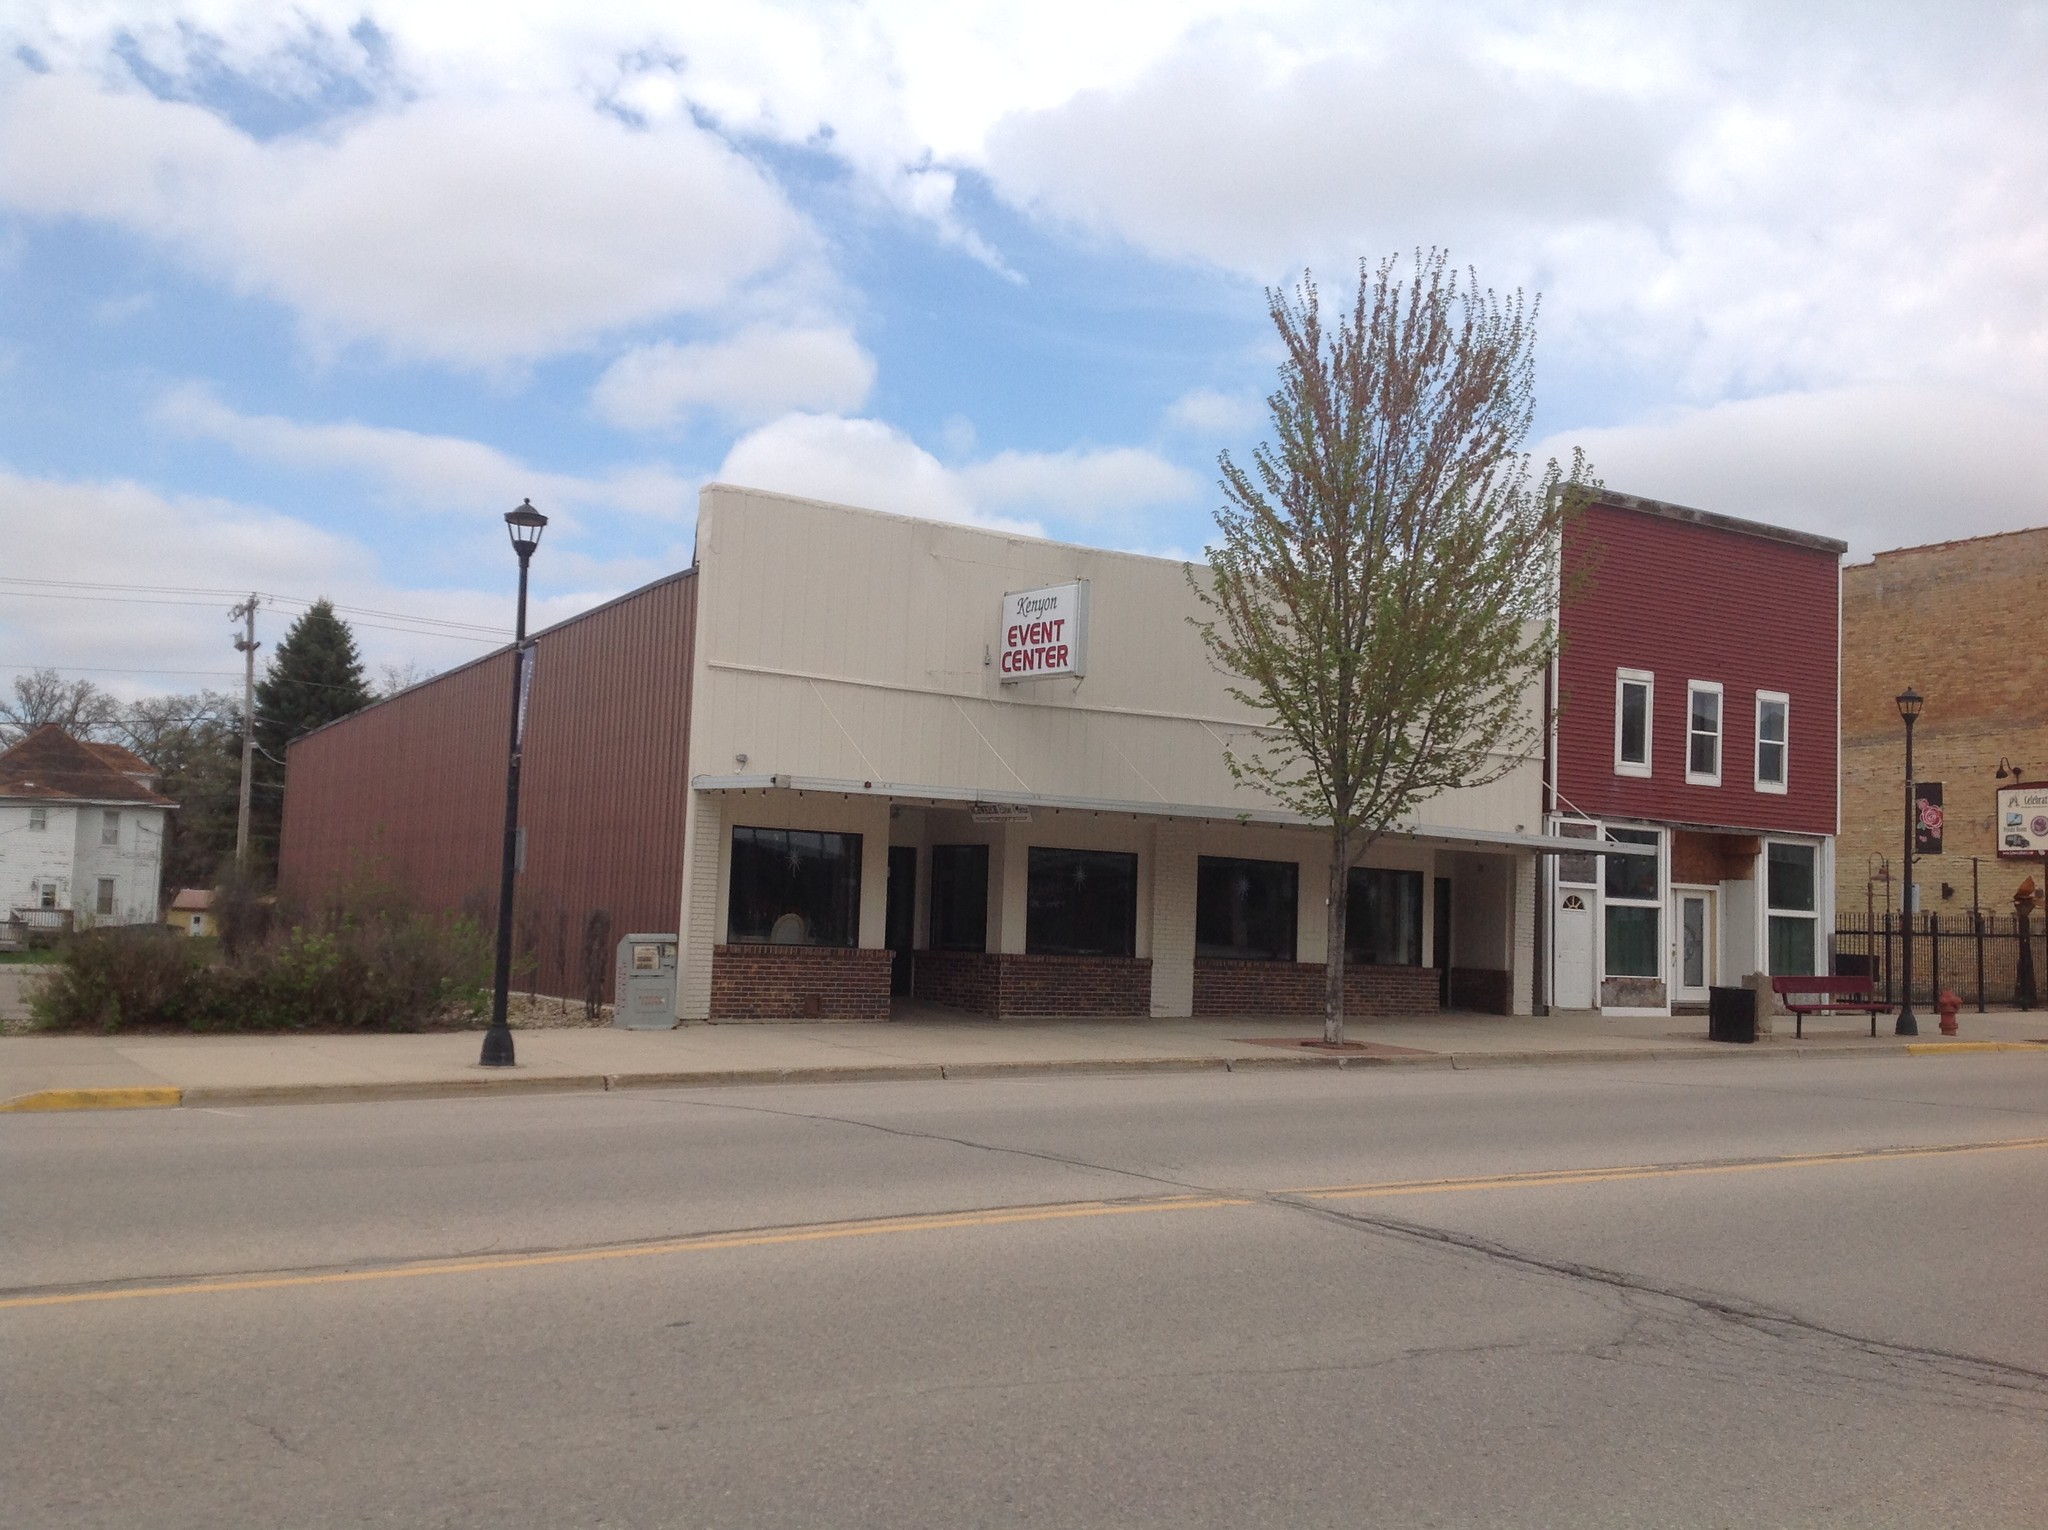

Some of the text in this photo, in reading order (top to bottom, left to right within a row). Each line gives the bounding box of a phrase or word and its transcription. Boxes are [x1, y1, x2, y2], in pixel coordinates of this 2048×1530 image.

[1016, 596, 1057, 620] Kenyon
[1007, 619, 1065, 647] EVENT
[1001, 645, 1068, 673] CENTER
